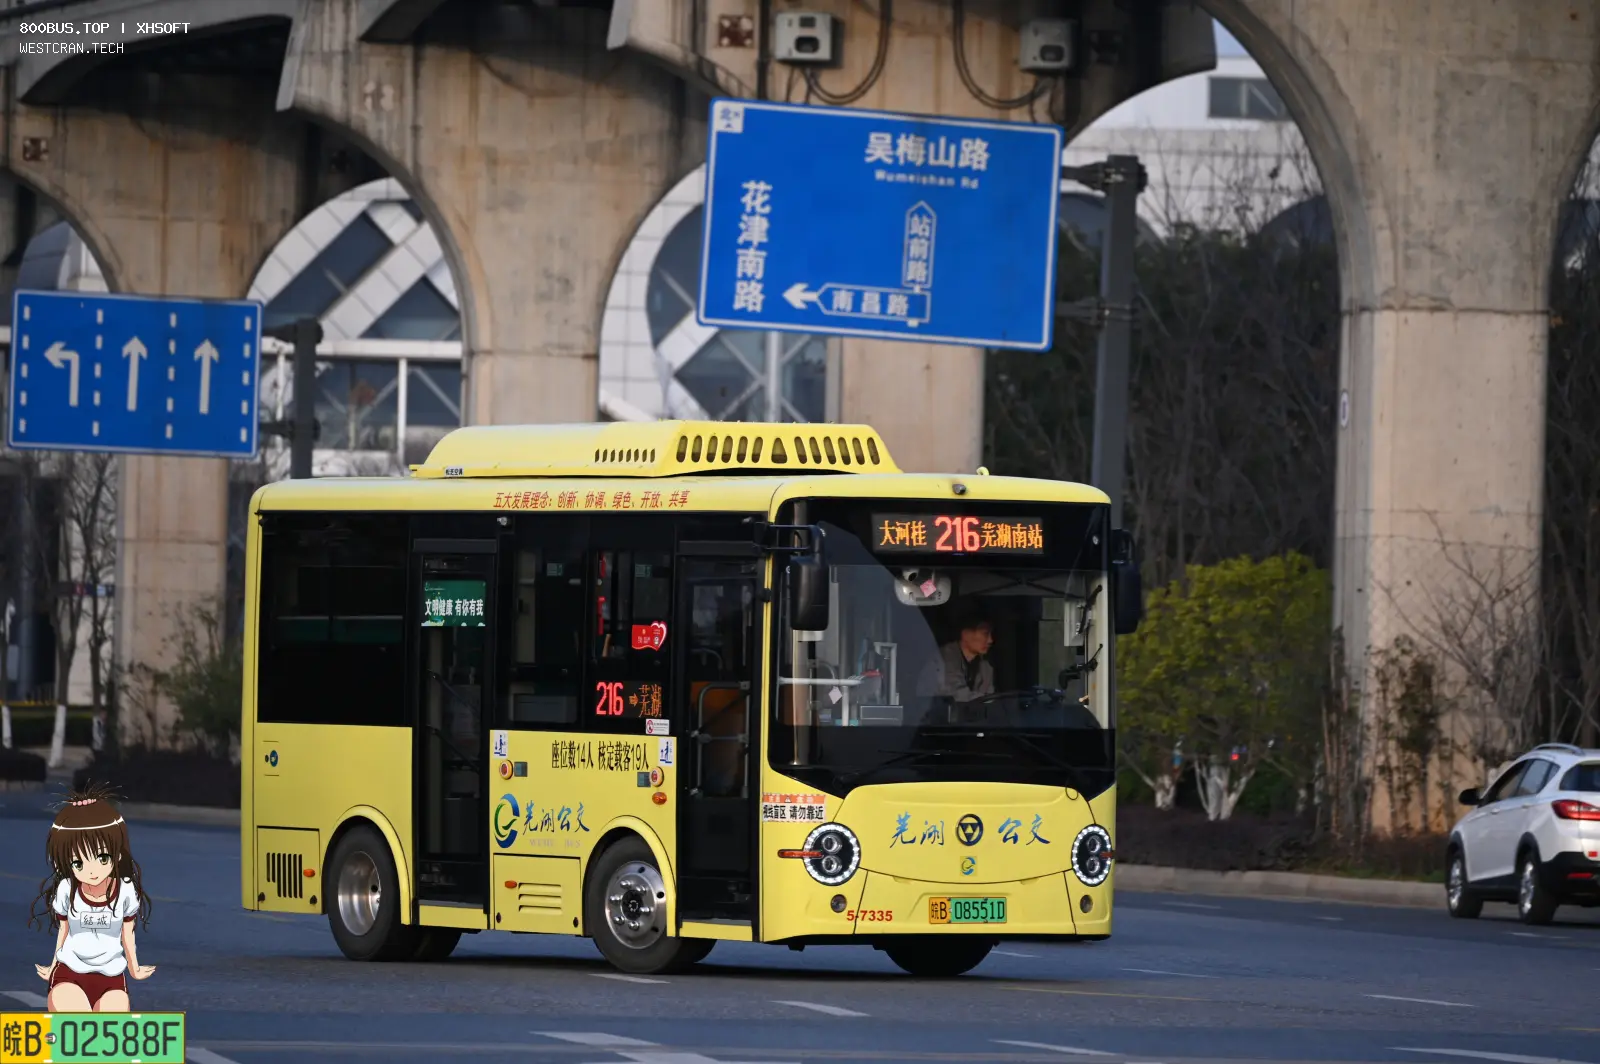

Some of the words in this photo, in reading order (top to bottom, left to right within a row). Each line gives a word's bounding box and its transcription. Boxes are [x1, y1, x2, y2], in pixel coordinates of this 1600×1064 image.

[864, 132, 990, 171] 吴梅山路
[732, 179, 773, 313] 花津南路
[907, 212, 932, 283] 站前路
[831, 289, 909, 316] 南昌路
[879, 520, 927, 546] 大河桂
[934, 516, 980, 551] 216
[981, 523, 1043, 549] 芜湖南站
[425, 598, 453, 616] 文明健康
[455, 598, 484, 617] 有你有我
[595, 681, 624, 716] 216
[639, 684, 662, 718] 芜湖
[551, 740, 594, 769] 座位数14人
[597, 741, 650, 772] 核定载客19人
[523, 799, 590, 835] 芜湖公交
[790, 805, 824, 820] 请勿靠近
[889, 811, 945, 848] 芜湖
[997, 813, 1051, 846] 公交
[846, 910, 893, 922] 5-7335
[931, 902, 948, 920] 皖B
[954, 901, 1005, 920] 08551D
